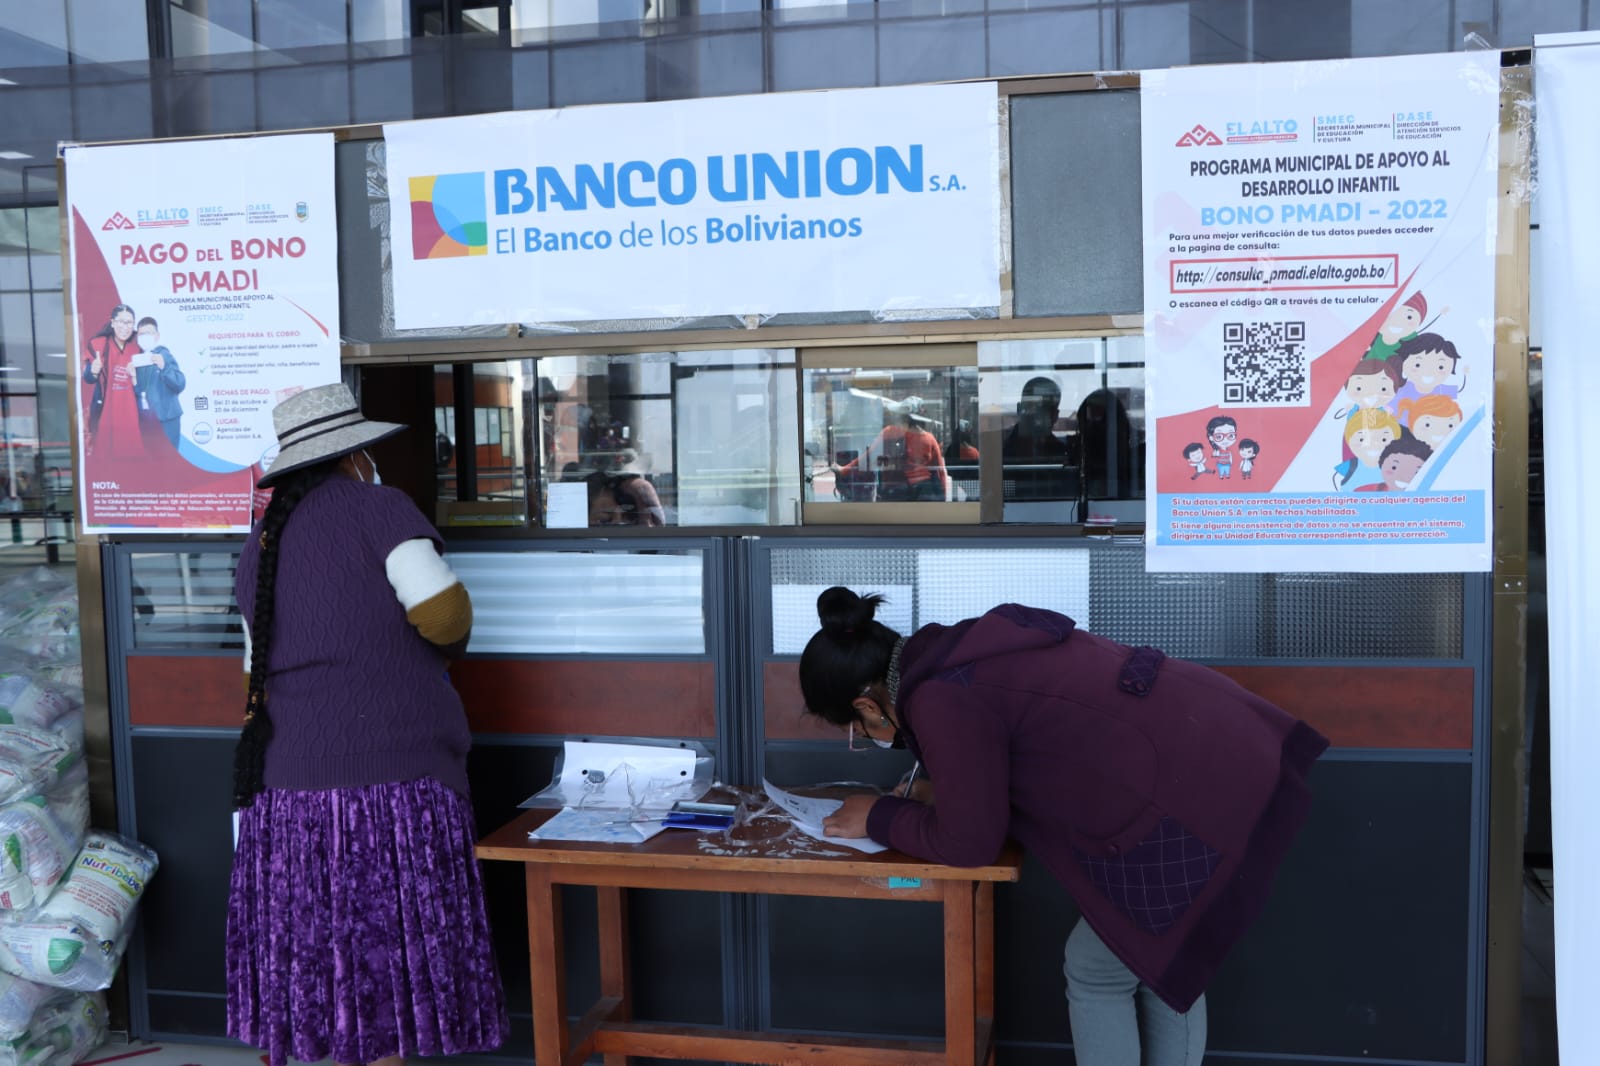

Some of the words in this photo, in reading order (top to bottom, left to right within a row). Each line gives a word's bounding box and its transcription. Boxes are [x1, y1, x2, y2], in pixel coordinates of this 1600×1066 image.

[1317, 115, 1355, 125] SMEC
[1396, 111, 1433, 122] DASE
[1226, 122, 1247, 136] EL
[1250, 119, 1298, 134] ALTO
[1190, 157, 1272, 177] PROGRAMA
[1275, 154, 1351, 173] MUNICIPAL
[1356, 152, 1374, 170] DE
[1378, 150, 1429, 168] APOYO
[1432, 150, 1450, 166] AL
[494, 158, 697, 215] BANCO
[707, 144, 923, 203] UNION
[929, 174, 967, 192] S.A.
[1242, 178, 1334, 198] DESARROLLO
[1338, 176, 1400, 194] INFANTIL
[156, 208, 189, 219] ALTO
[1201, 204, 1274, 226] BONO
[1281, 202, 1361, 223] PMADI
[1387, 198, 1448, 220] 2022
[496, 227, 516, 254] El
[524, 227, 612, 253] Banco
[619, 220, 654, 248] de
[661, 219, 698, 246] los
[706, 213, 863, 244] Bolivianos
[1169, 233, 1190, 241] Para
[1212, 231, 1239, 241] mejor
[1241, 228, 1295, 239] verificación
[1297, 229, 1309, 237] de
[1328, 228, 1355, 236] datos
[1357, 227, 1392, 237] puedes
[1394, 225, 1434, 234] acceder
[120, 242, 188, 265] PAGO
[196, 248, 223, 262] DEL
[230, 236, 306, 260] BONO
[1178, 244, 1186, 252] la
[1188, 243, 1221, 254] pagina
[1223, 243, 1235, 251] de
[1237, 242, 1280, 250] consulta:
[171, 269, 258, 294] PMADI
[179, 304, 222, 312] DESARROLLO
[1169, 300, 1176, 308] O
[1179, 300, 1218, 308] escanea
[1220, 298, 1228, 306] el
[1230, 298, 1262, 308] código
[1264, 298, 1278, 306] QR
[1289, 296, 1318, 305] través
[1320, 296, 1332, 304] de
[1335, 296, 1345, 304] tu
[1172, 498, 1180, 506] Si
[1194, 498, 1218, 506] datos
[1220, 497, 1244, 506] están
[1289, 496, 1322, 506] puedes
[1323, 496, 1359, 506] dirigirte
[1368, 496, 1411, 506] cualquier
[1413, 496, 1449, 504] agencia
[1451, 495, 1466, 504] del
[1274, 508, 1304, 516] fechas
[1171, 522, 1179, 530] Si
[1180, 522, 1201, 530] tiene
[1204, 522, 1232, 530] alguna
[1234, 521, 1292, 530] inconsistencia
[1294, 521, 1304, 529] de
[1306, 520, 1330, 528] datos
[1362, 520, 1405, 528] encuentra
[1420, 520, 1428, 528] el
[1171, 532, 1204, 541] dirigirse
[1256, 532, 1297, 540] Educativa
[1298, 531, 1368, 540] correspondiente
[1368, 532, 1388, 540] para
